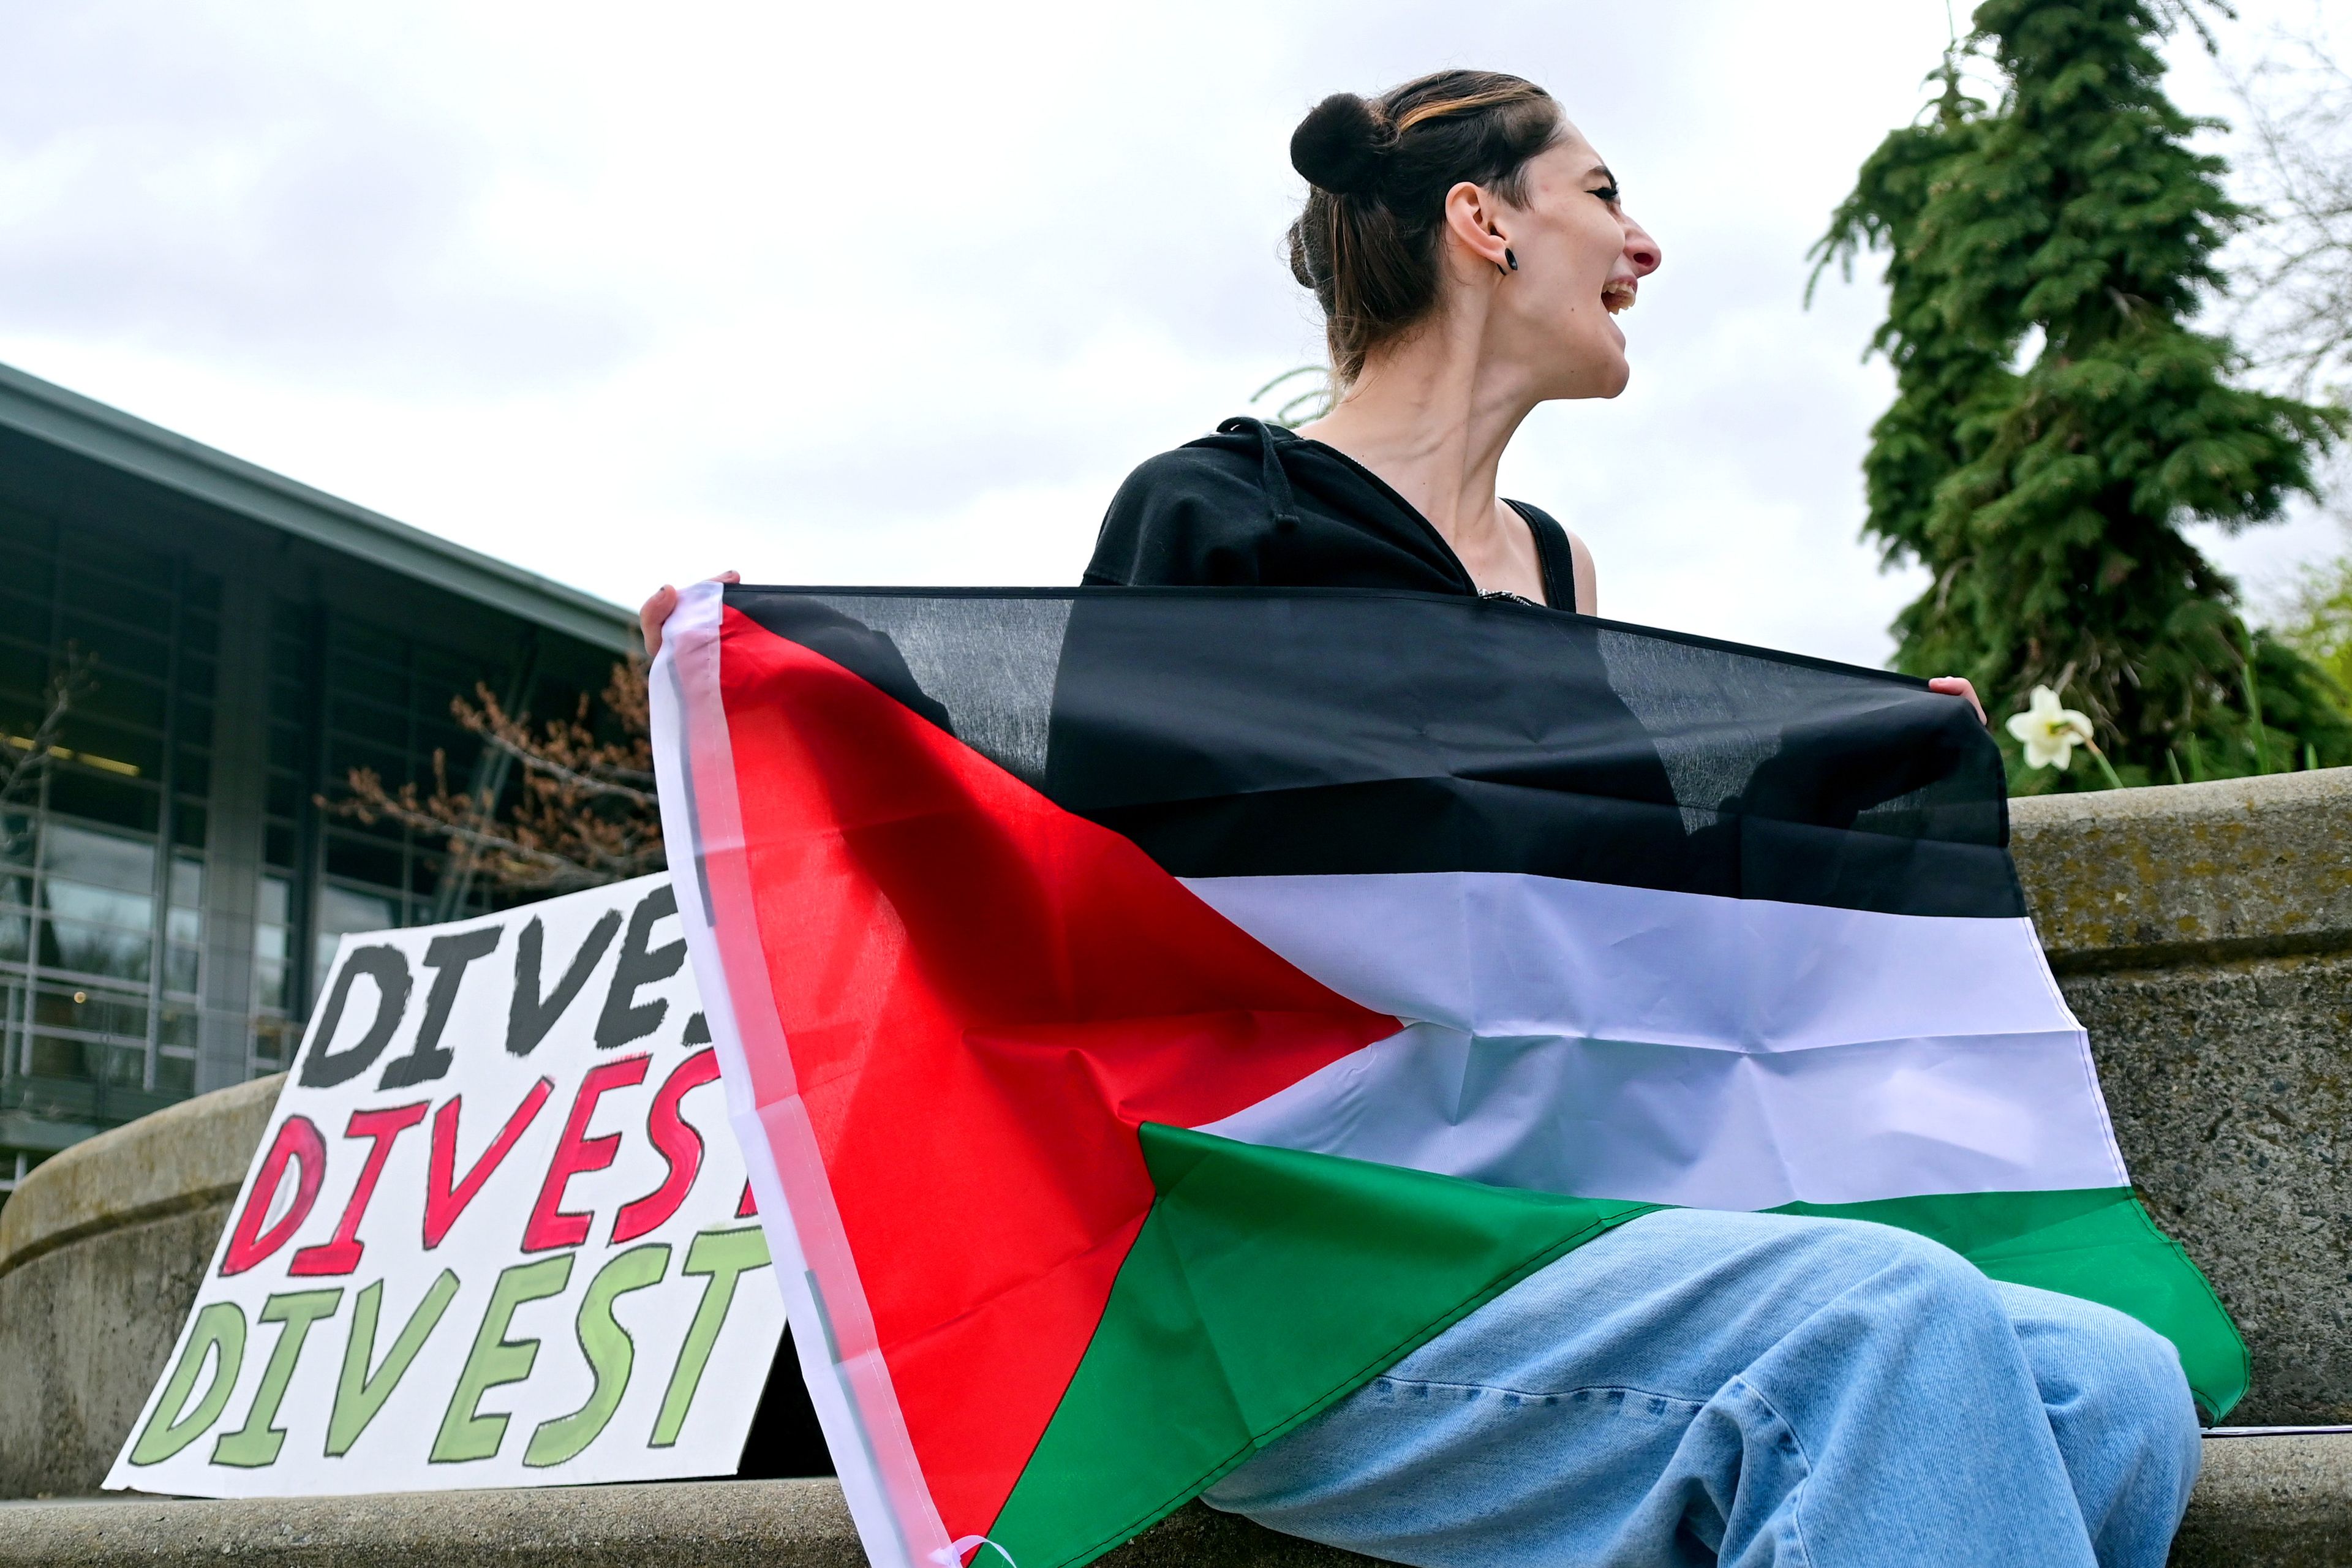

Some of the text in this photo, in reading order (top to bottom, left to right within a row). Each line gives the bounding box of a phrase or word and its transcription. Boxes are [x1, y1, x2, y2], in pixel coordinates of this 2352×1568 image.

[298, 883, 713, 1091] DIVE
[217, 1047, 758, 1277] DIVES
[127, 1226, 773, 1467] DIVEST
